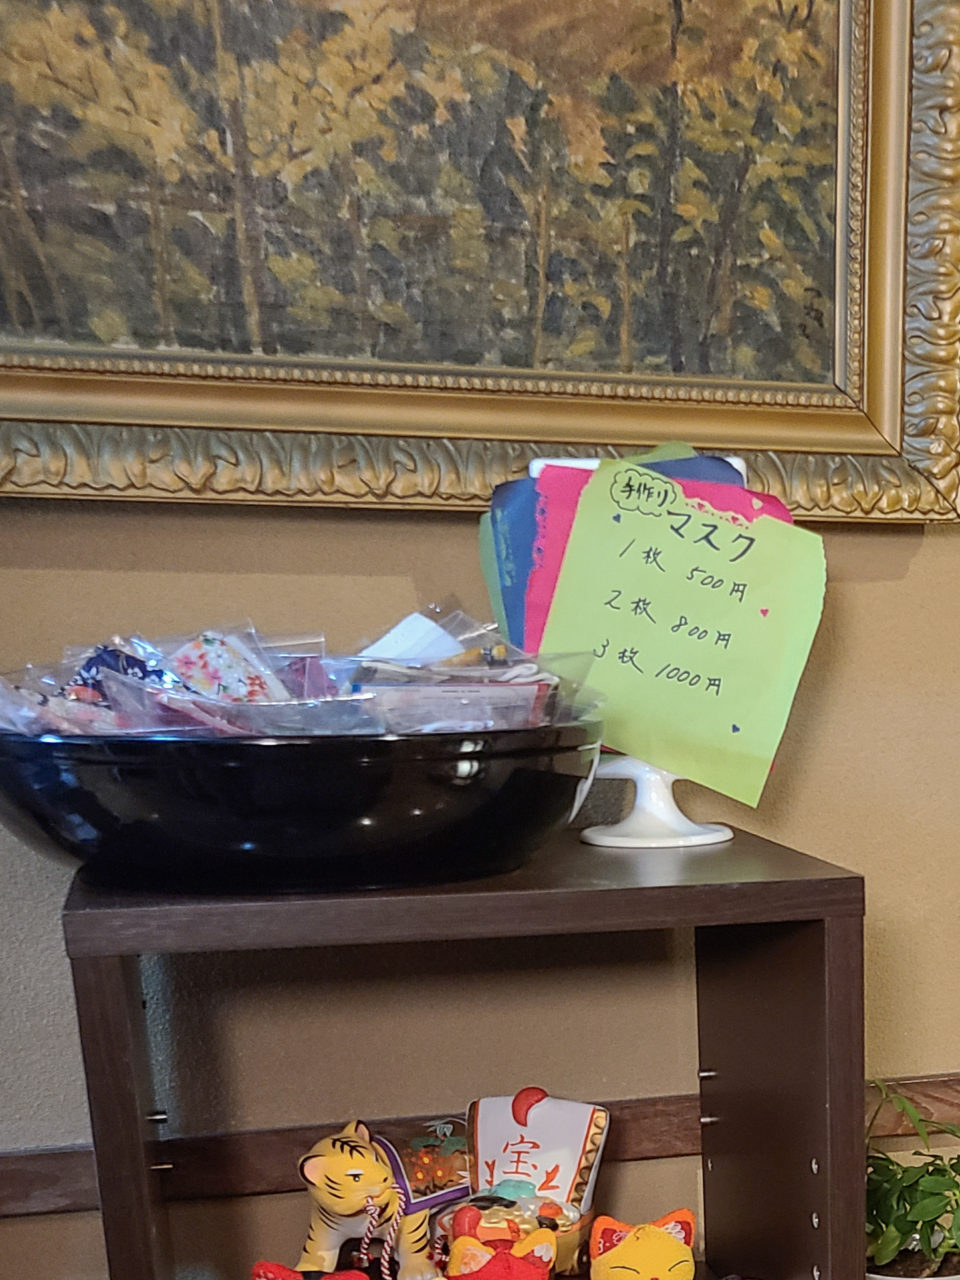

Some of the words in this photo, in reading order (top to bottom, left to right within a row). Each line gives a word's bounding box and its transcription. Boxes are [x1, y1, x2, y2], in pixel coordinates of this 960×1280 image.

[620, 476, 669, 508] 手作り
[666, 509, 756, 563] マスク
[686, 566, 748, 603] 500円
[671, 615, 732, 649] 800円
[655, 663, 722, 696] 1000円
[502, 1133, 541, 1178] 宝
